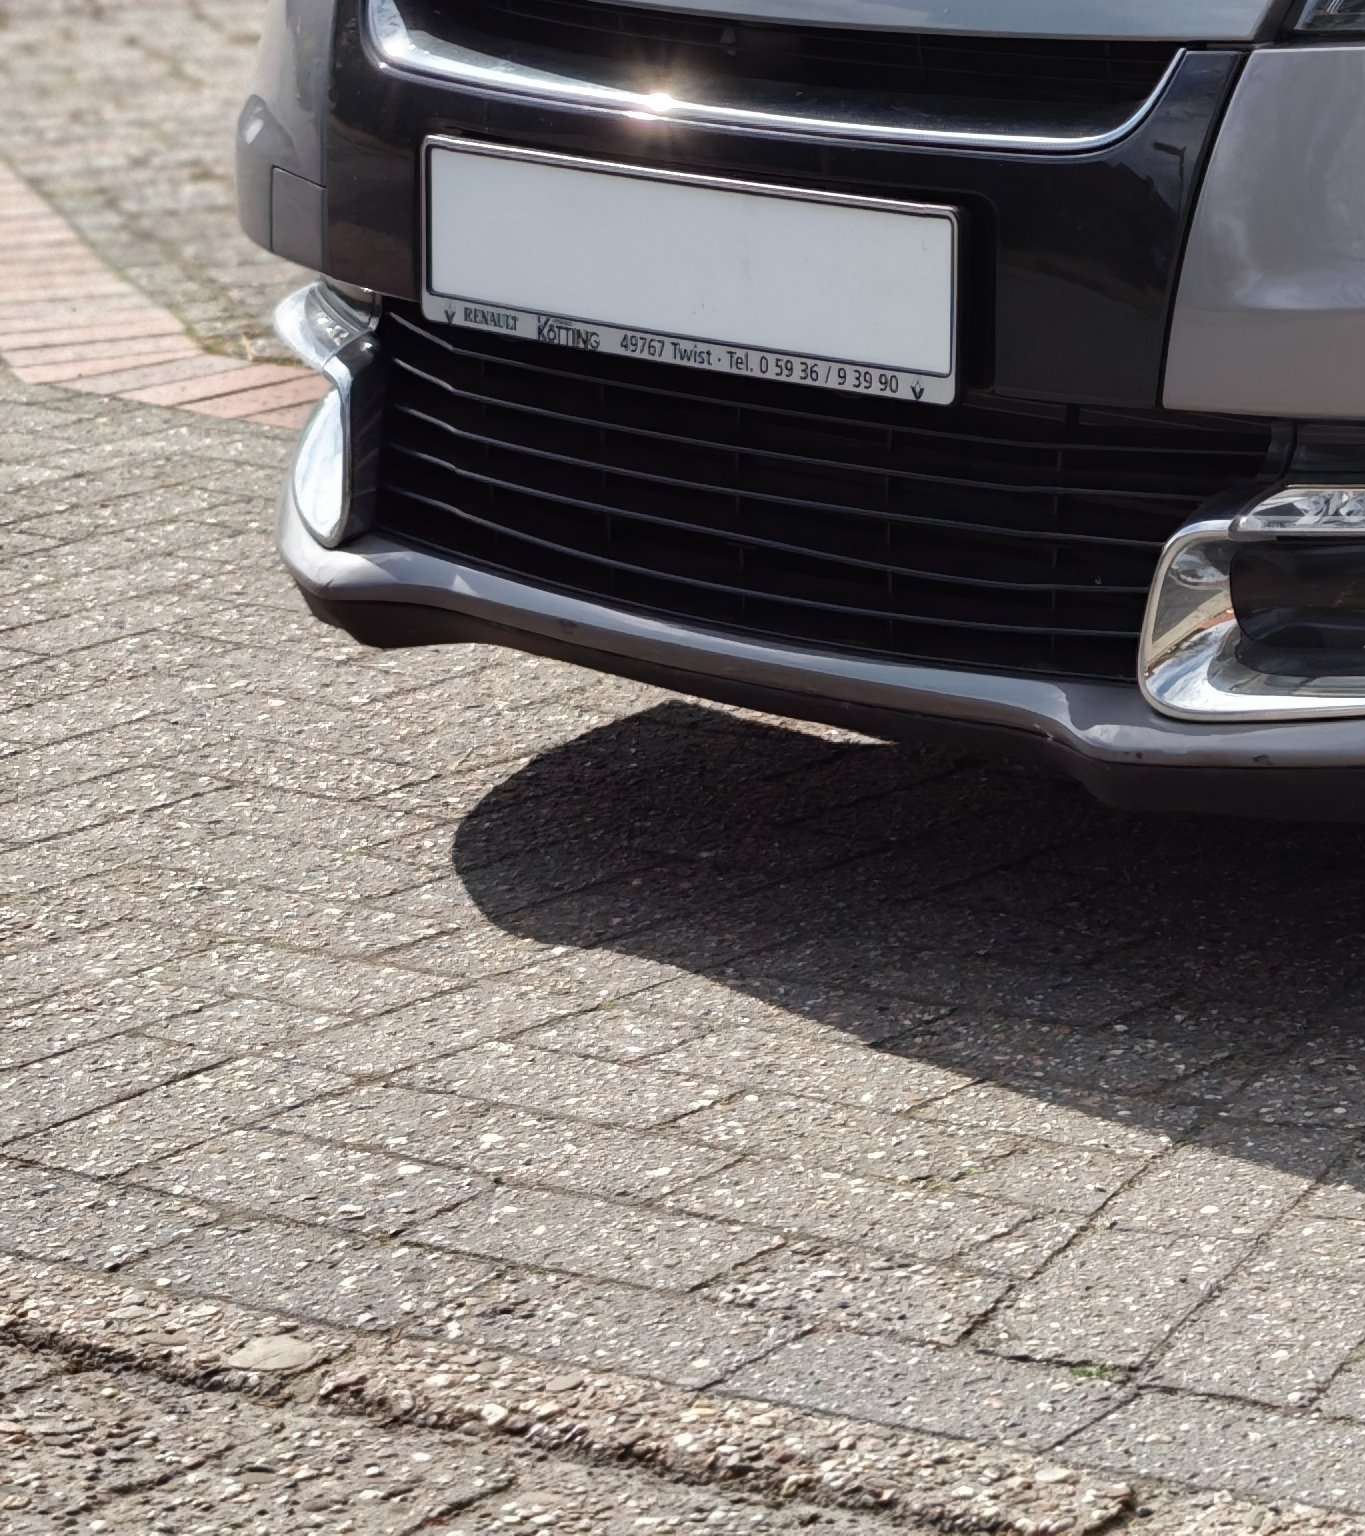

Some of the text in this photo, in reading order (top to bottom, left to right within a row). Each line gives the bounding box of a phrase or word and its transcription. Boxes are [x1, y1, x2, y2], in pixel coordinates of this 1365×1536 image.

[463, 307, 519, 331] RENAULT
[620, 333, 665, 358] 49767
[670, 341, 713, 366] Twist
[726, 350, 754, 372] Tel.
[759, 354, 769, 374] 0
[775, 357, 794, 378] 59
[799, 361, 819, 382] 36
[824, 365, 832, 385] /
[837, 367, 847, 386] 9
[852, 369, 873, 390] 39
[878, 373, 899, 394] 90
